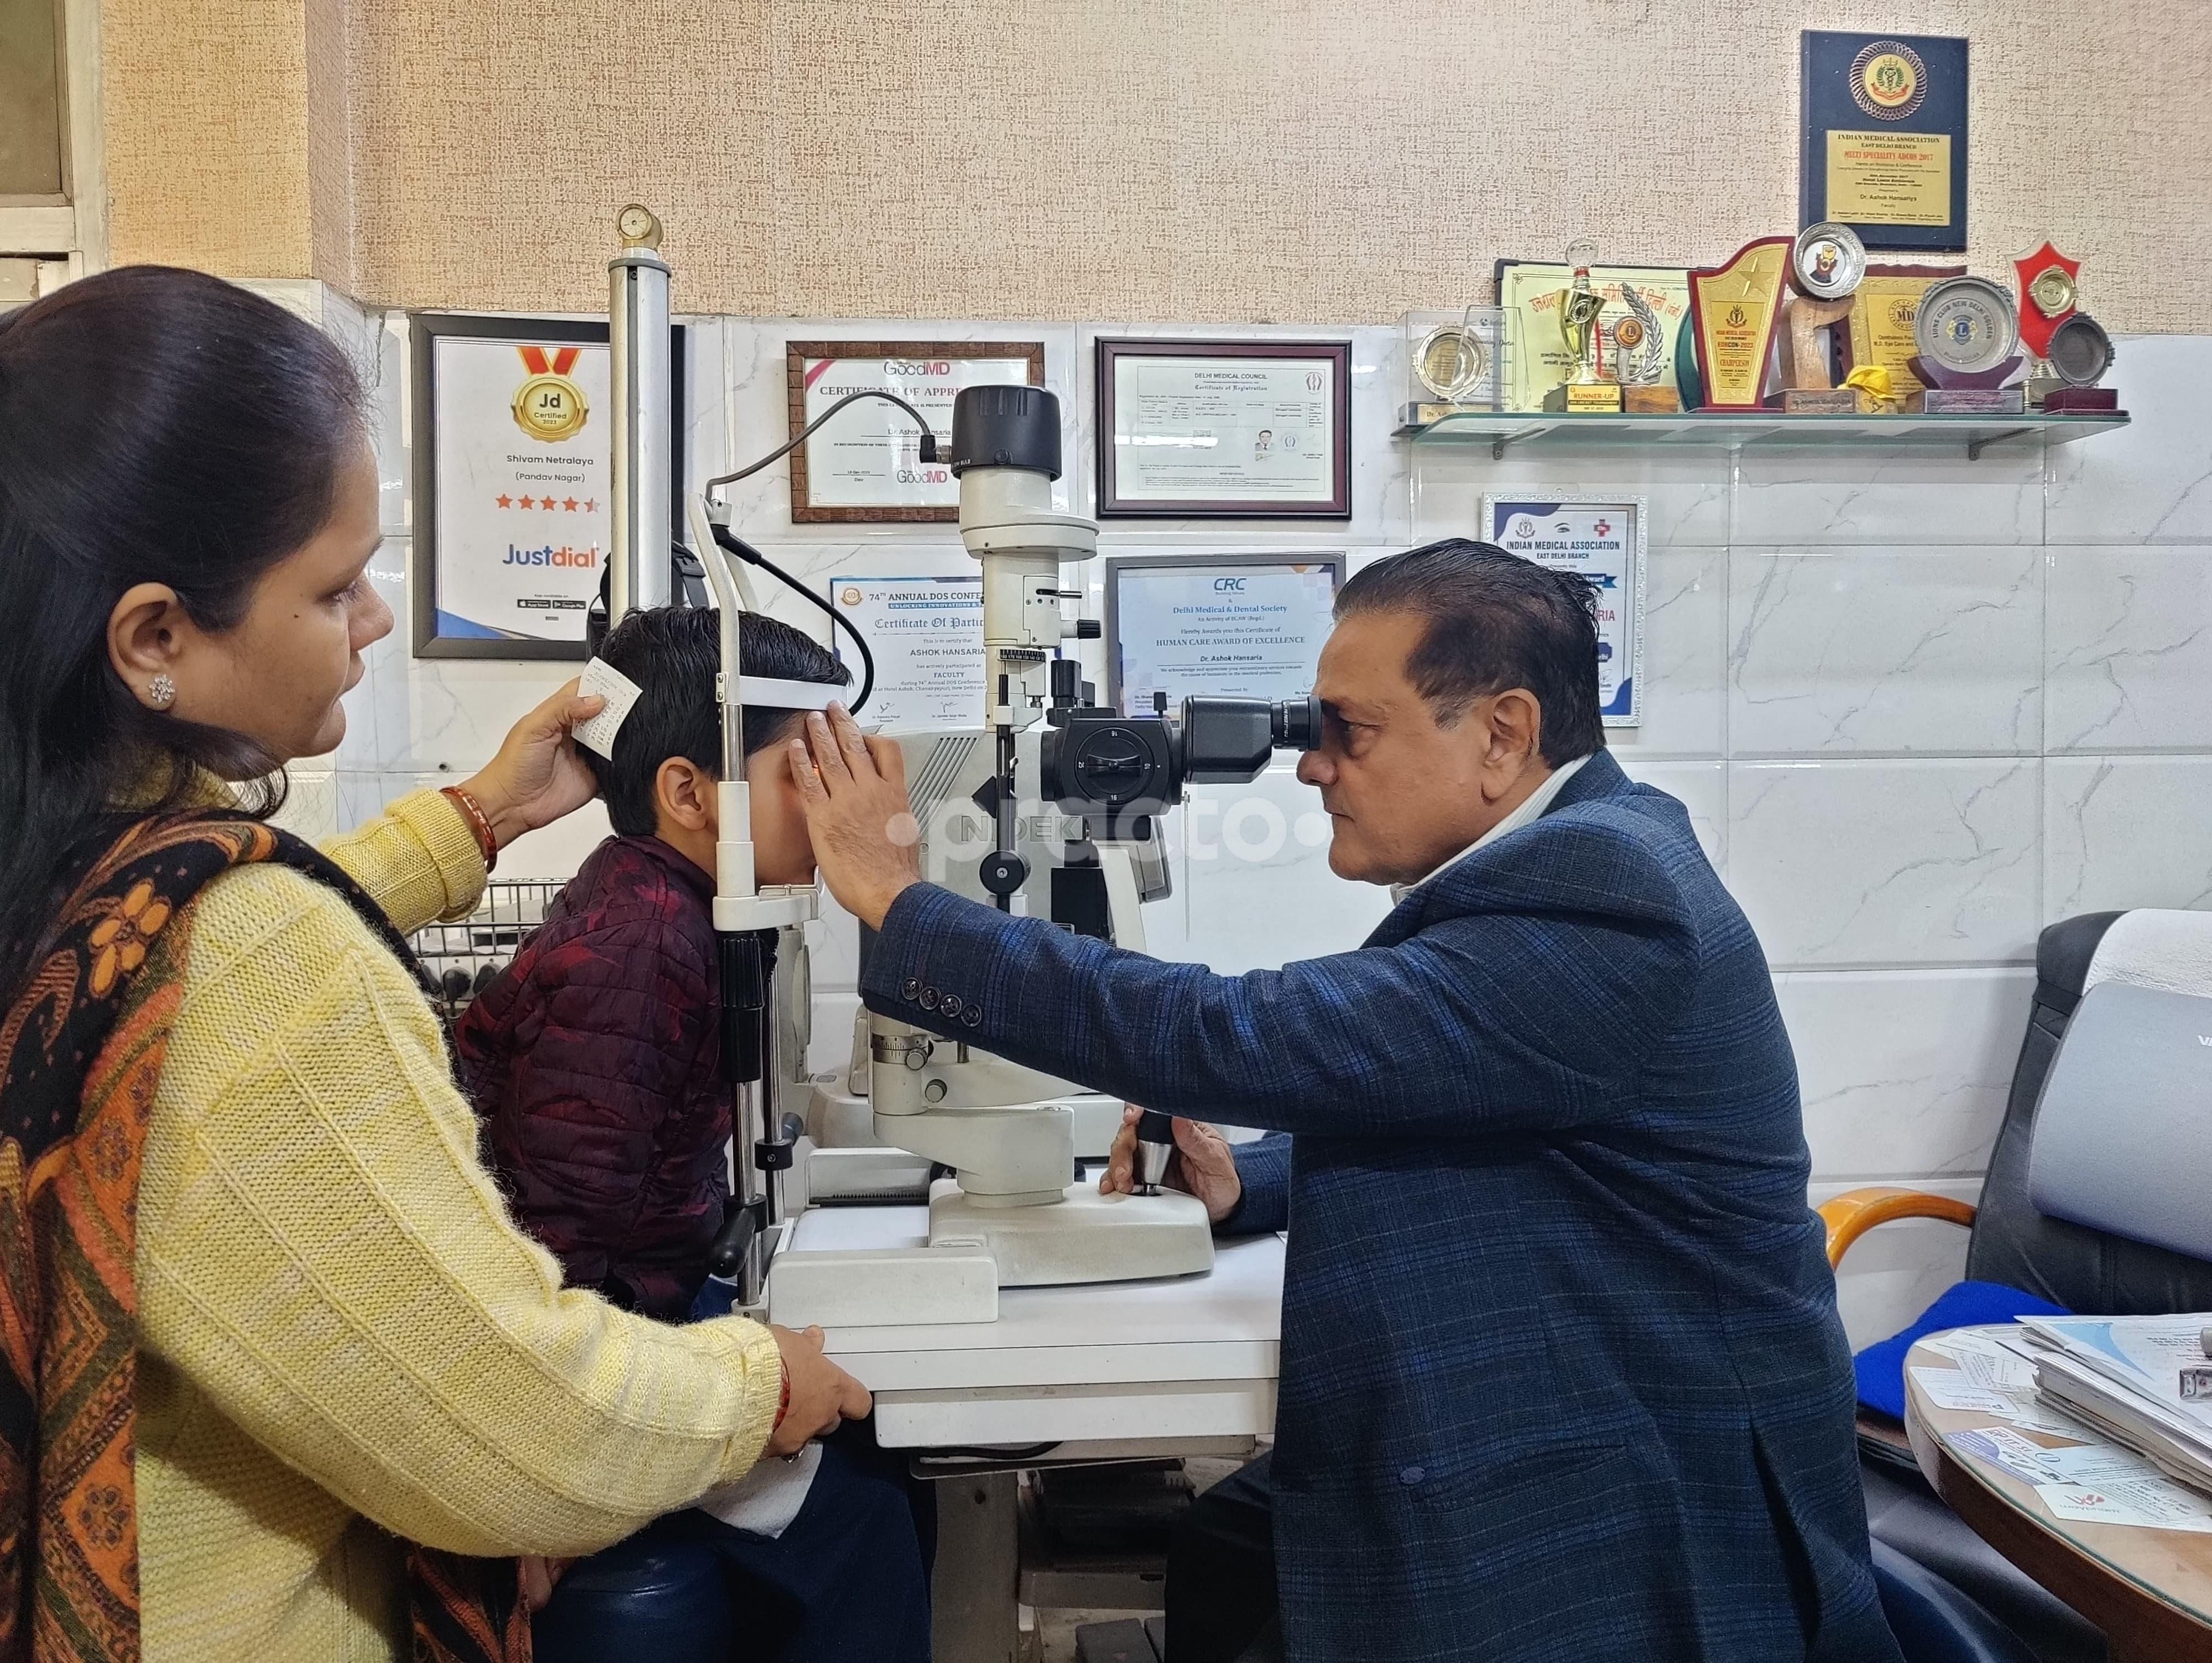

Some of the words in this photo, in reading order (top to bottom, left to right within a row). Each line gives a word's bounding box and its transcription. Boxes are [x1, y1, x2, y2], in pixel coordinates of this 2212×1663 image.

[1863, 151, 1895, 160] SPECIALITY
[1897, 311, 1915, 322] MD
[1937, 305, 1952, 318] CLUB
[1968, 301, 1986, 315] DELHI
[1983, 315, 1994, 339] GOLDEN
[884, 362, 950, 375] GoodMD
[905, 387, 920, 396] OF
[539, 393, 561, 408] Jd
[507, 455, 544, 463] Shivam
[546, 456, 593, 467] Netralaya
[515, 471, 552, 480] (Pandav
[555, 473, 586, 483] Nagar)
[897, 469, 947, 483] GoodMD
[1506, 541, 1532, 550] INDIAN
[1535, 541, 1568, 550] MEDICAL
[1570, 541, 1620, 550] ASSOCIATION
[503, 543, 596, 568] Justdial
[1214, 578, 1246, 590] CRC
[888, 593, 928, 601] ANNUAL
[875, 619, 928, 629] Certificate
[931, 618, 946, 627] Of
